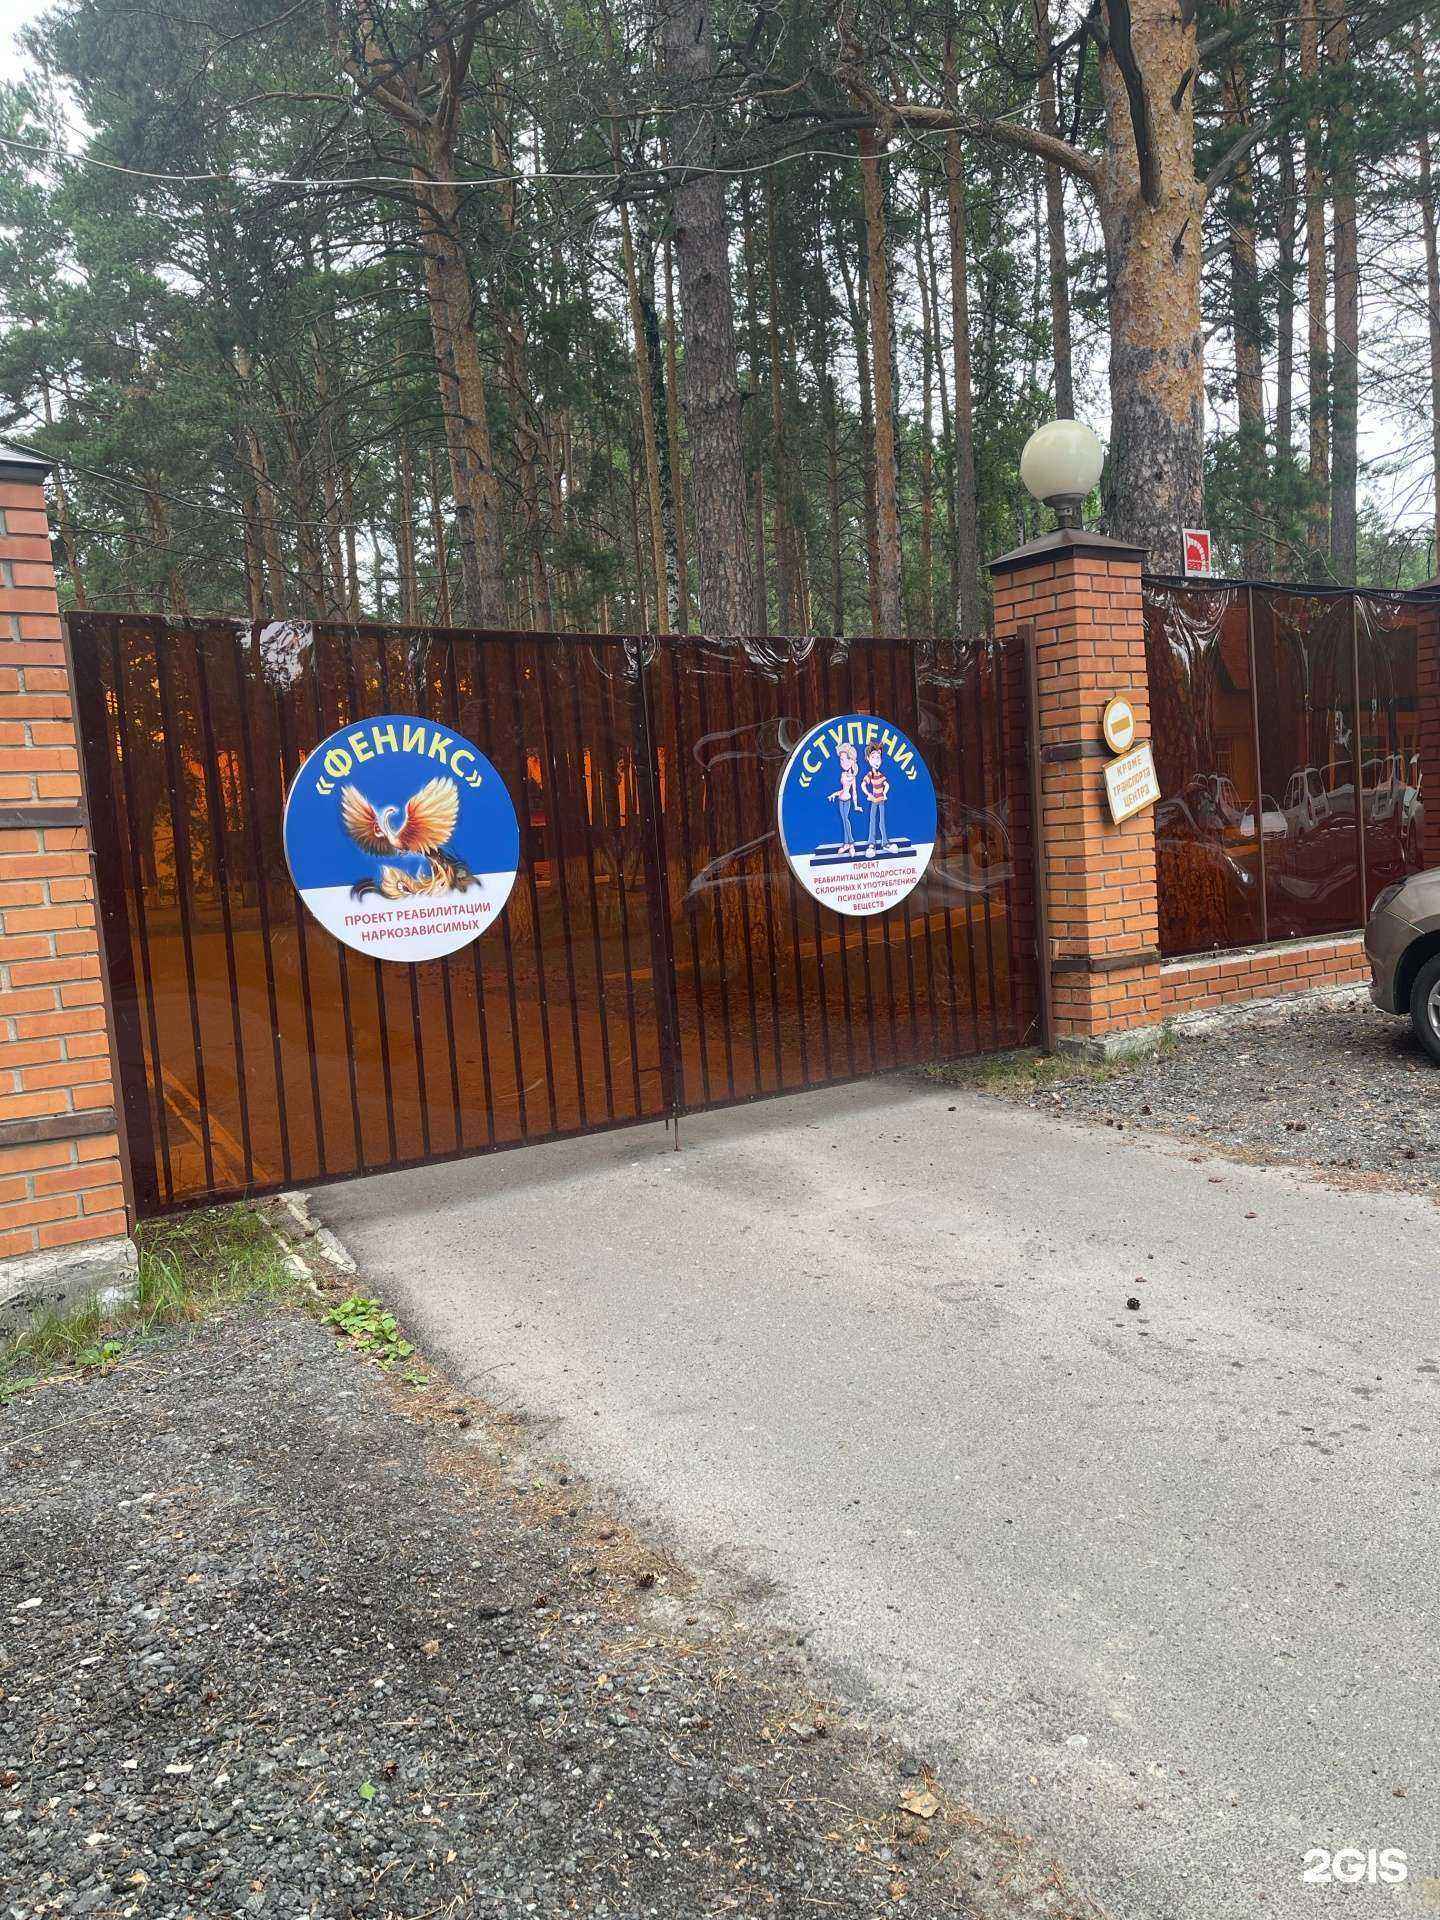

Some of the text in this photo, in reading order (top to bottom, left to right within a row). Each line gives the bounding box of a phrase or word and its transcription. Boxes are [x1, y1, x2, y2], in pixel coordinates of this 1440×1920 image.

[315, 724, 482, 795] «ФЕНИКС»
[799, 721, 917, 787] «СТУПЕНИ»
[853, 861, 880, 870] ПРОЕКТ
[813, 873, 869, 885] РЕАБИЛИТАЦИИ
[815, 884, 857, 894] СКЛОННЫХ
[863, 877, 917, 890] УПОТРЕБЛЕНИЮ
[837, 889, 898, 902] ПСИХОАКТИВНЫХ
[344, 902, 491, 926] ПРОЕКТ РЕАБИЛИТАЦИИ
[853, 901, 885, 911] ВЕЩЕСТВ
[361, 919, 480, 942] НАРКОЗАВИСИМЫХ
